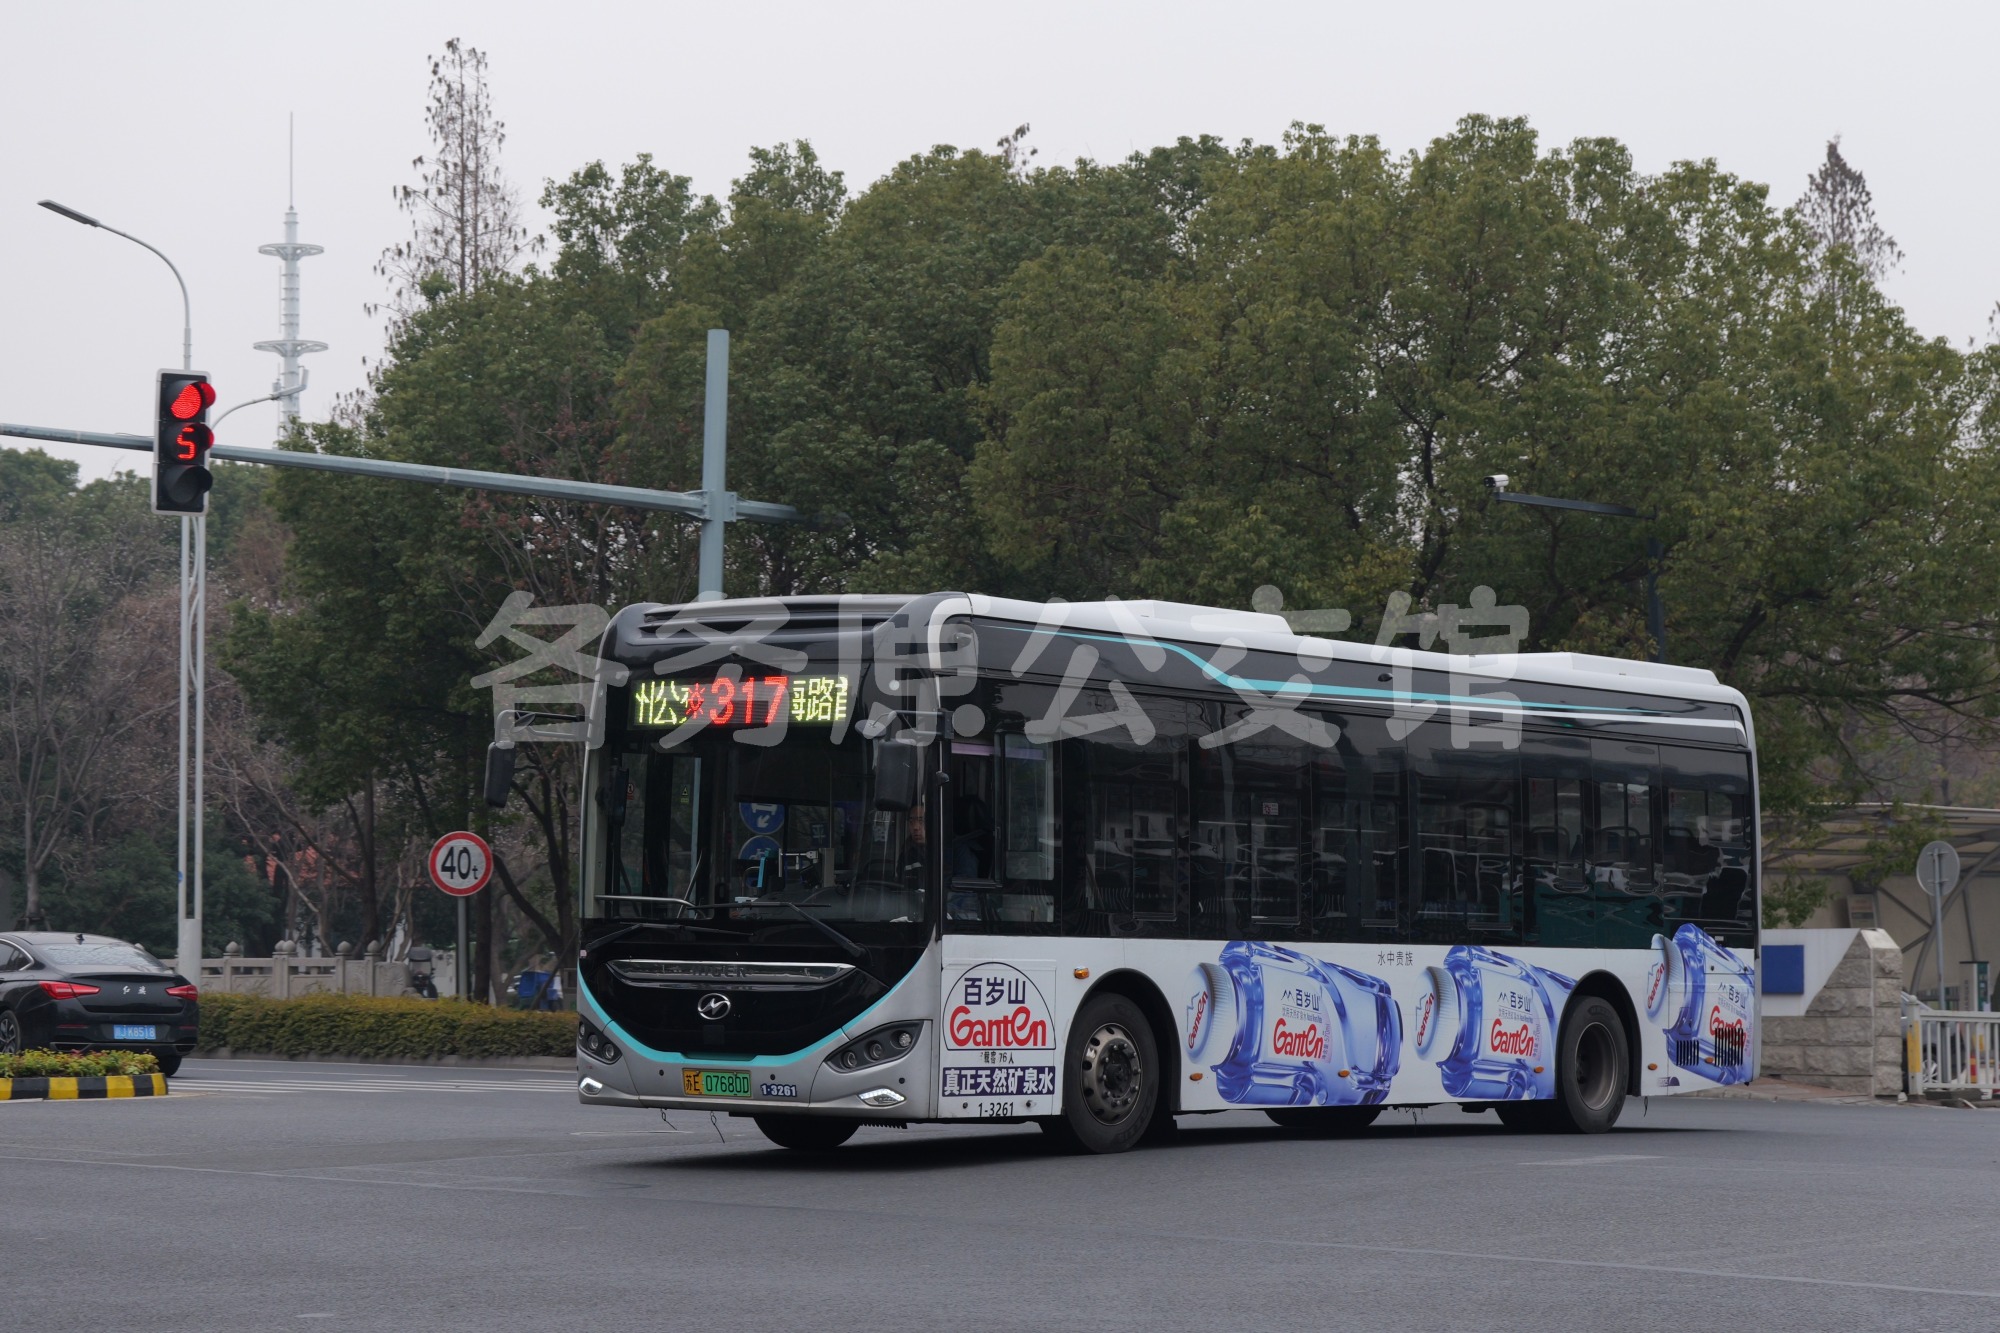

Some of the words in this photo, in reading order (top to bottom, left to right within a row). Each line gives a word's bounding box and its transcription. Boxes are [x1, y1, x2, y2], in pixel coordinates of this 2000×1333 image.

[176, 427, 196, 460] 5
[709, 676, 788, 725] 317
[440, 846, 479, 880] 40t
[1377, 951, 1414, 967] 水中贵族
[963, 976, 1026, 1006] 百岁山
[1295, 988, 1320, 1011] 百岁山
[1510, 991, 1531, 1013] 百岁山
[114, 1025, 156, 1038] JK8518
[949, 1005, 1047, 1047] Ganten
[1188, 990, 1209, 1050] Ganten
[1416, 992, 1435, 1047] Ganten
[1273, 1017, 1324, 1059] Ganten
[1490, 1018, 1534, 1057] Ganten
[944, 1067, 1054, 1096] 真正天然矿泉水
[978, 1101, 1014, 1117] 1-3261
